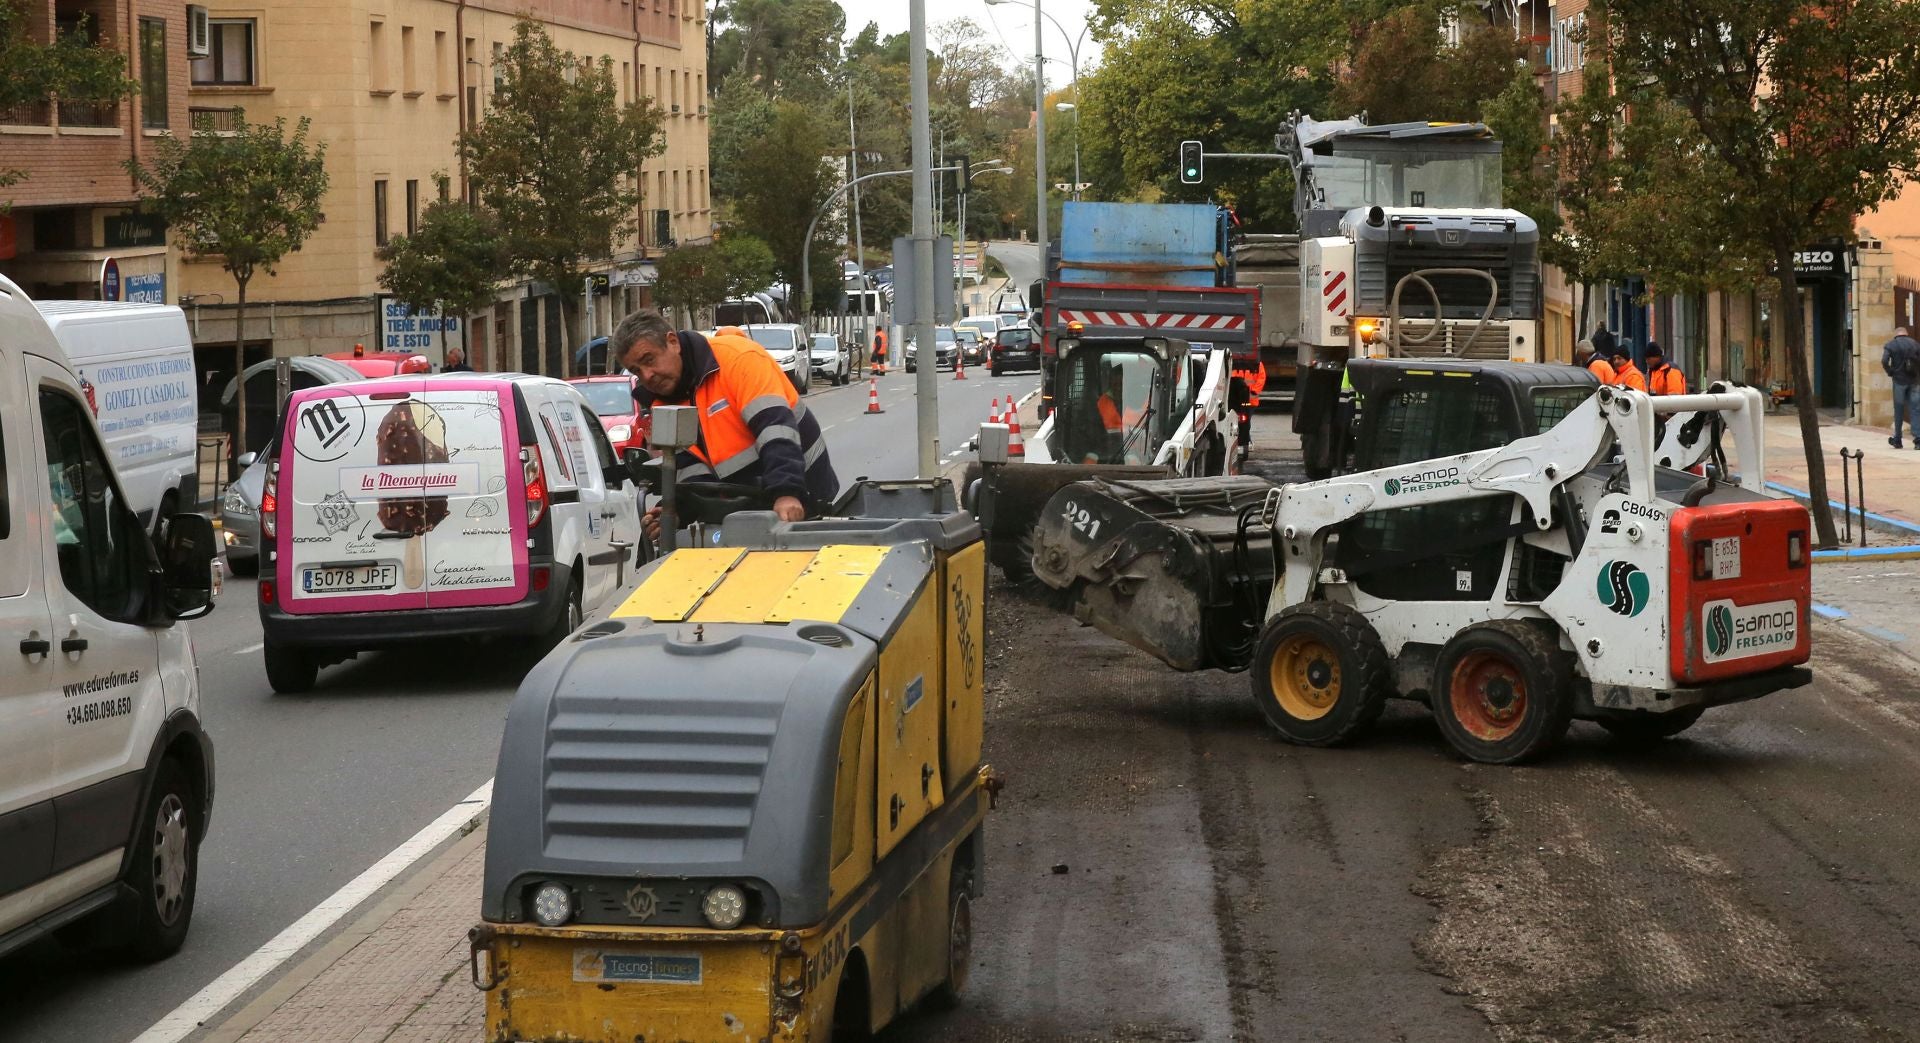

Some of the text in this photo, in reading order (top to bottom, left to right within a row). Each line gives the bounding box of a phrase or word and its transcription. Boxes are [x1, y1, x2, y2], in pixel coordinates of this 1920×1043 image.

[386, 318, 457, 332] TIENE MUCHO
[386, 334, 431, 348] DE ESTO
[105, 388, 137, 411] GOMEZ
[144, 383, 175, 405] CASADO
[362, 472, 457, 489] la Menorquina
[1402, 479, 1460, 494] FRESADO
[1061, 501, 1101, 540] 221
[433, 559, 486, 574] Creación
[315, 568, 391, 587] 5078 JPF
[430, 573, 513, 587] Mediterránea
[1736, 630, 1795, 649] FRESADO
[63, 670, 140, 698] www.edureform.es
[66, 696, 132, 725] +34.660.098.650
[610, 959, 649, 973] Tecno
